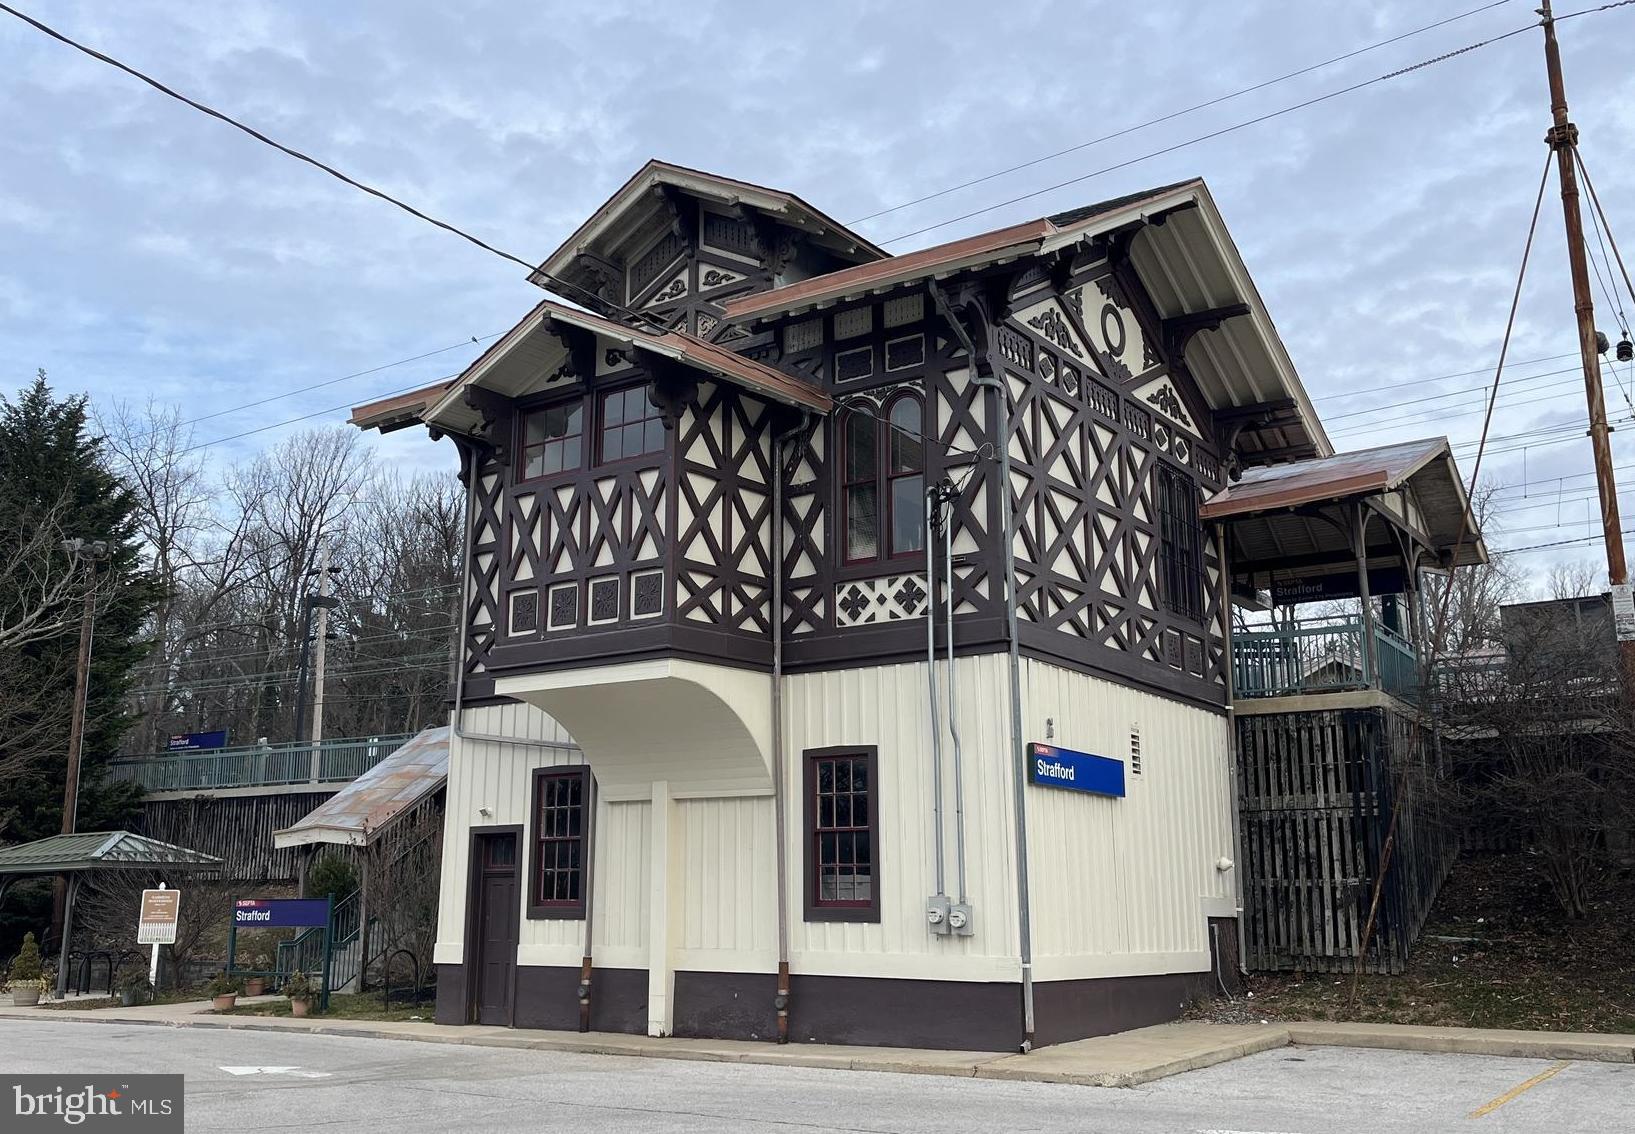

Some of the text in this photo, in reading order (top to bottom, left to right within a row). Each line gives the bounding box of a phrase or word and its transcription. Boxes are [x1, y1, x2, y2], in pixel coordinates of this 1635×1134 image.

[1276, 584, 1323, 596] Strafford
[1037, 759, 1075, 781] Strafford
[236, 910, 271, 922] Strafford
